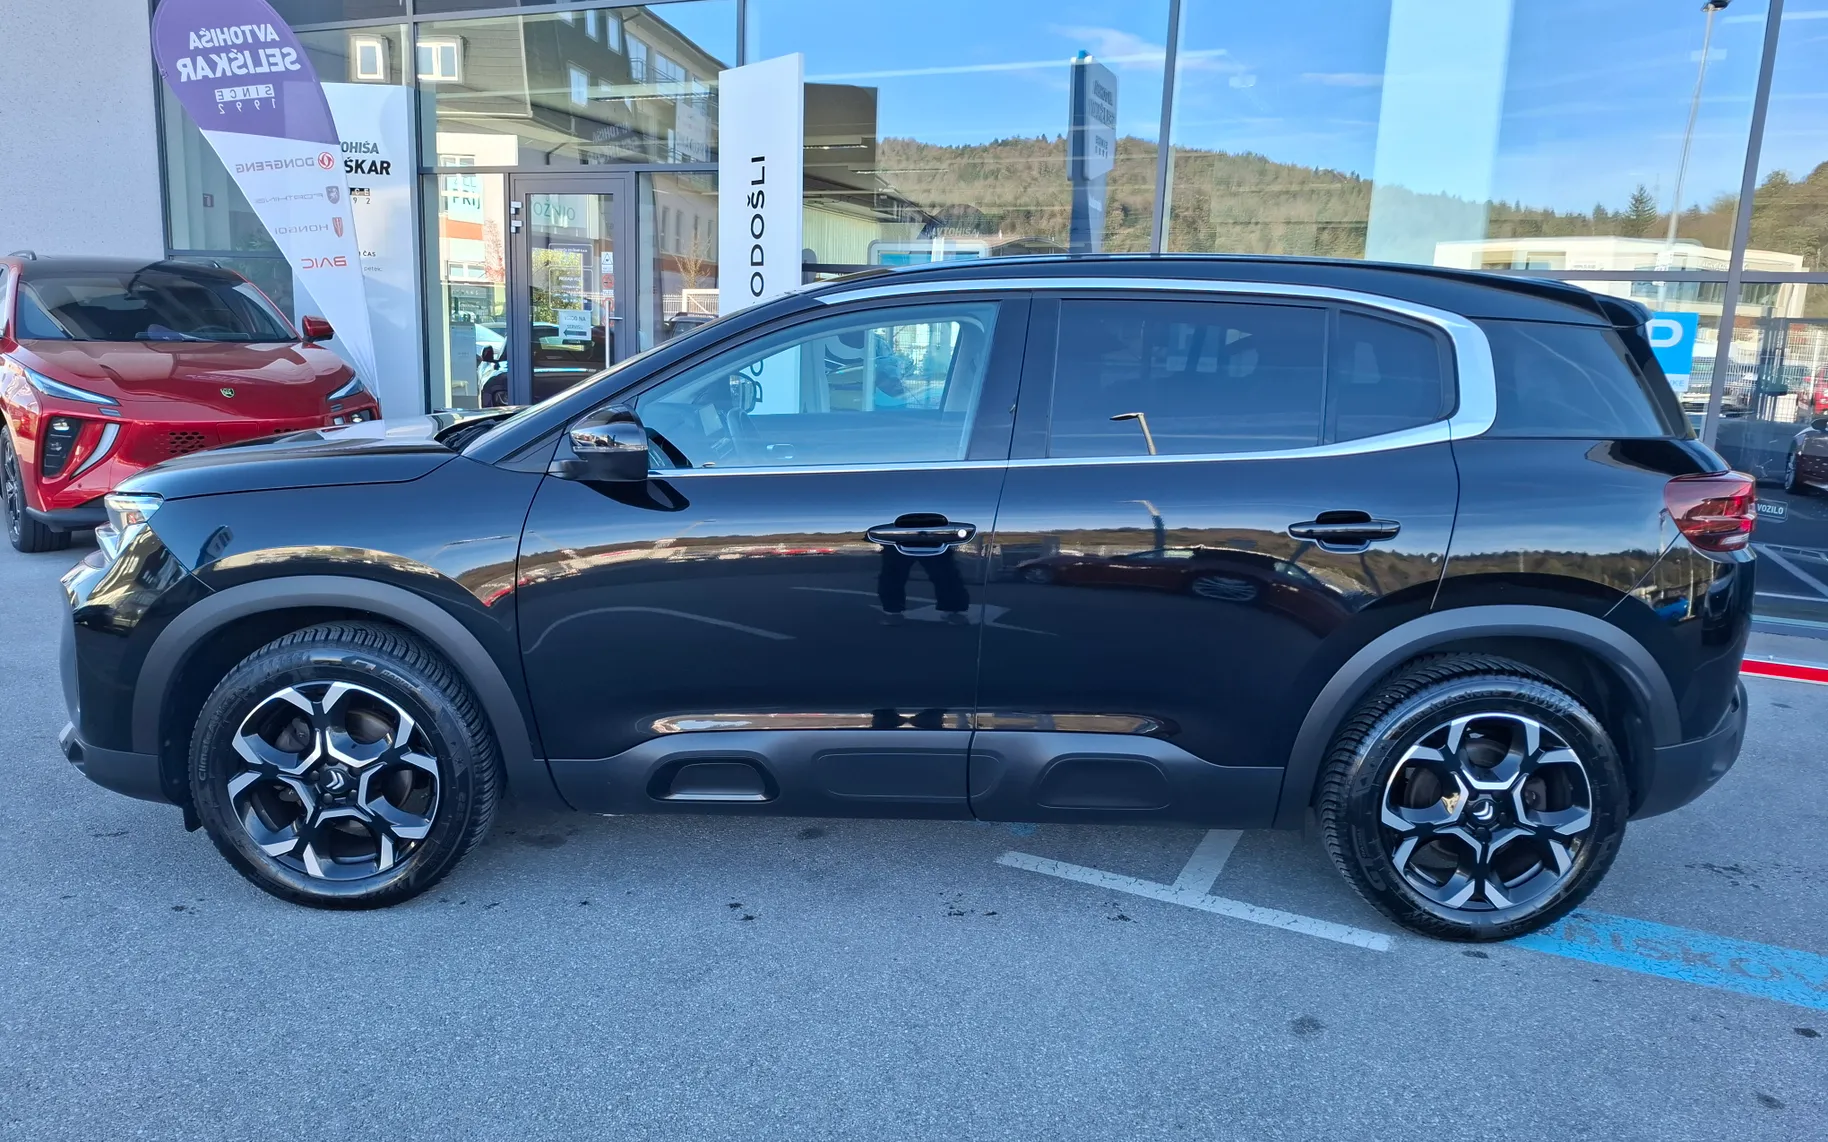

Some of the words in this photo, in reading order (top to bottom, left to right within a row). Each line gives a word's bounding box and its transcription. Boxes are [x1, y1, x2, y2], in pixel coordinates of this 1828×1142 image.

[340, 141, 380, 155] OHIŠA
[344, 157, 392, 175] ŠKAR
[1645, 318, 1684, 348] P
[1756, 503, 1784, 515] VOZILO
